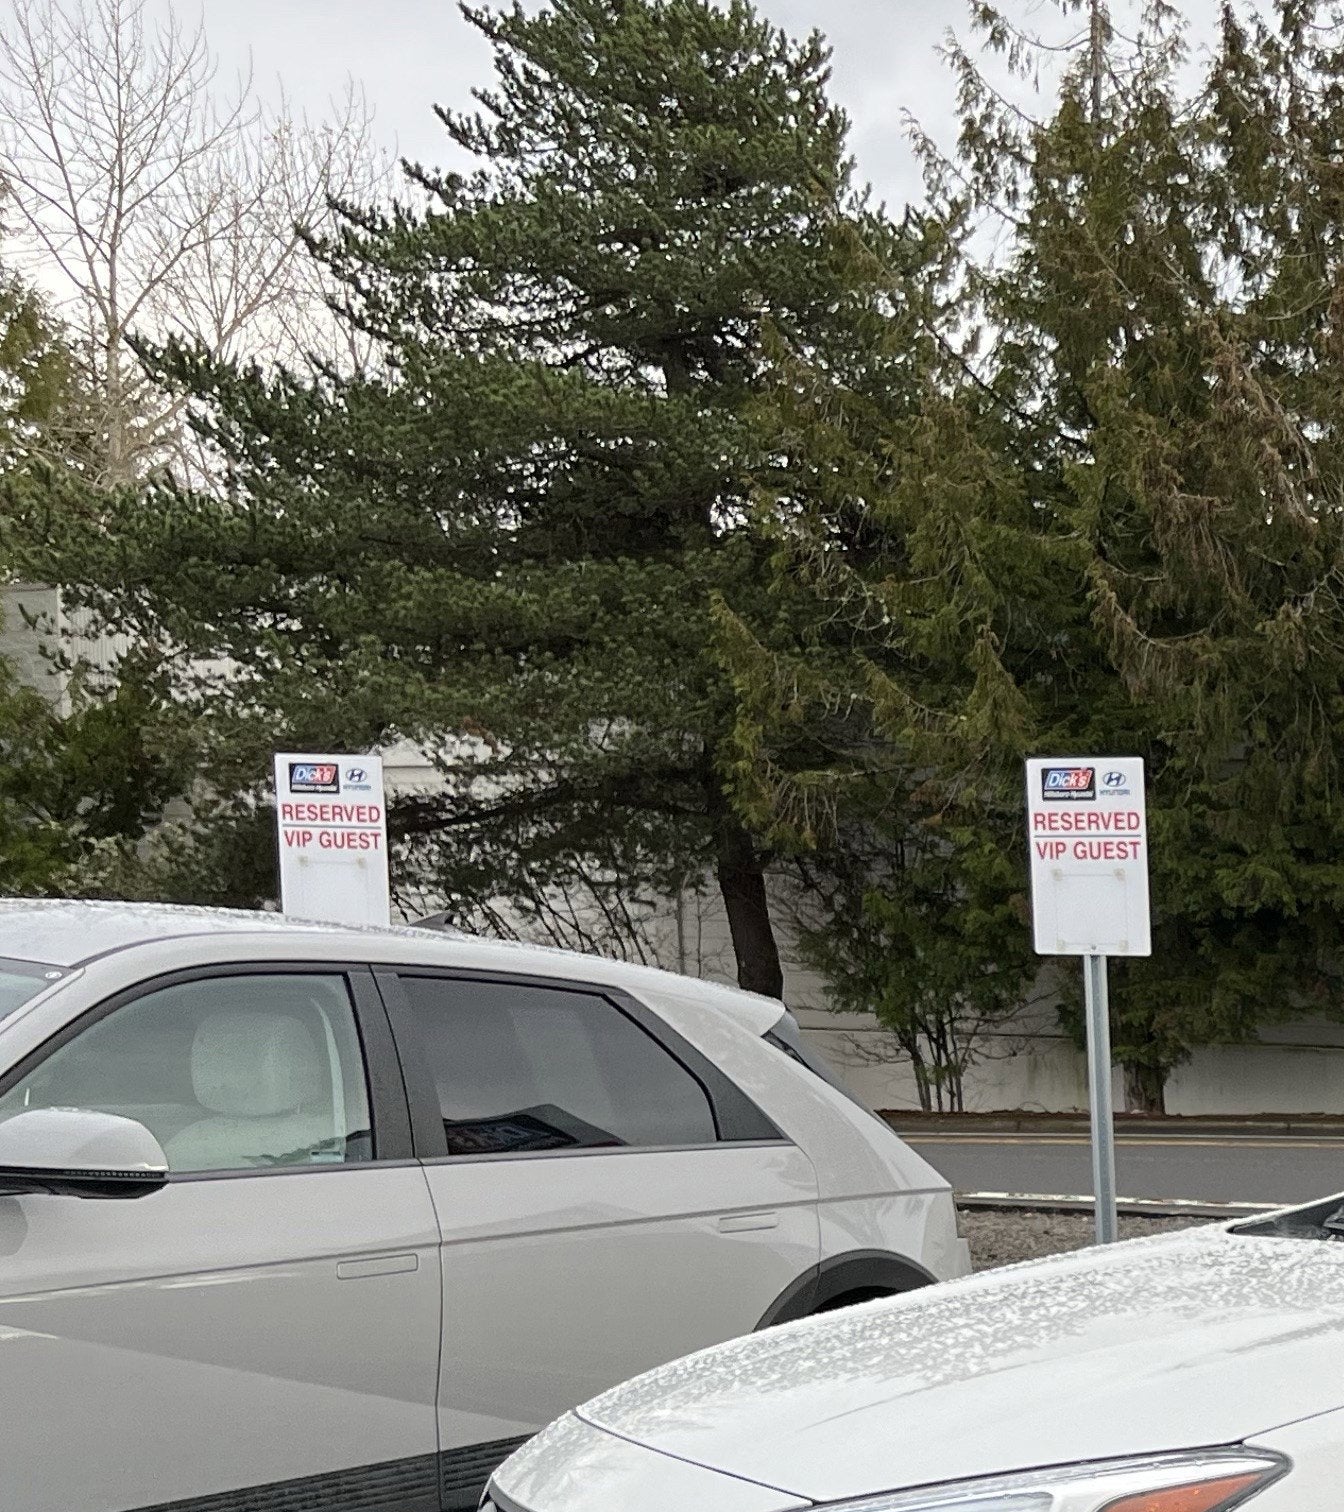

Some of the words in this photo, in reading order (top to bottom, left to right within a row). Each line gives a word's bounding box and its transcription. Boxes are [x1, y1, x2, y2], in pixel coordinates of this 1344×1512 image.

[281, 803, 381, 823] RESERVED
[1033, 812, 1140, 831] RESERVED
[284, 830, 313, 848] VIP
[319, 831, 381, 850] GUEST
[1035, 841, 1067, 860] VIP
[1073, 841, 1141, 860] GUEST
